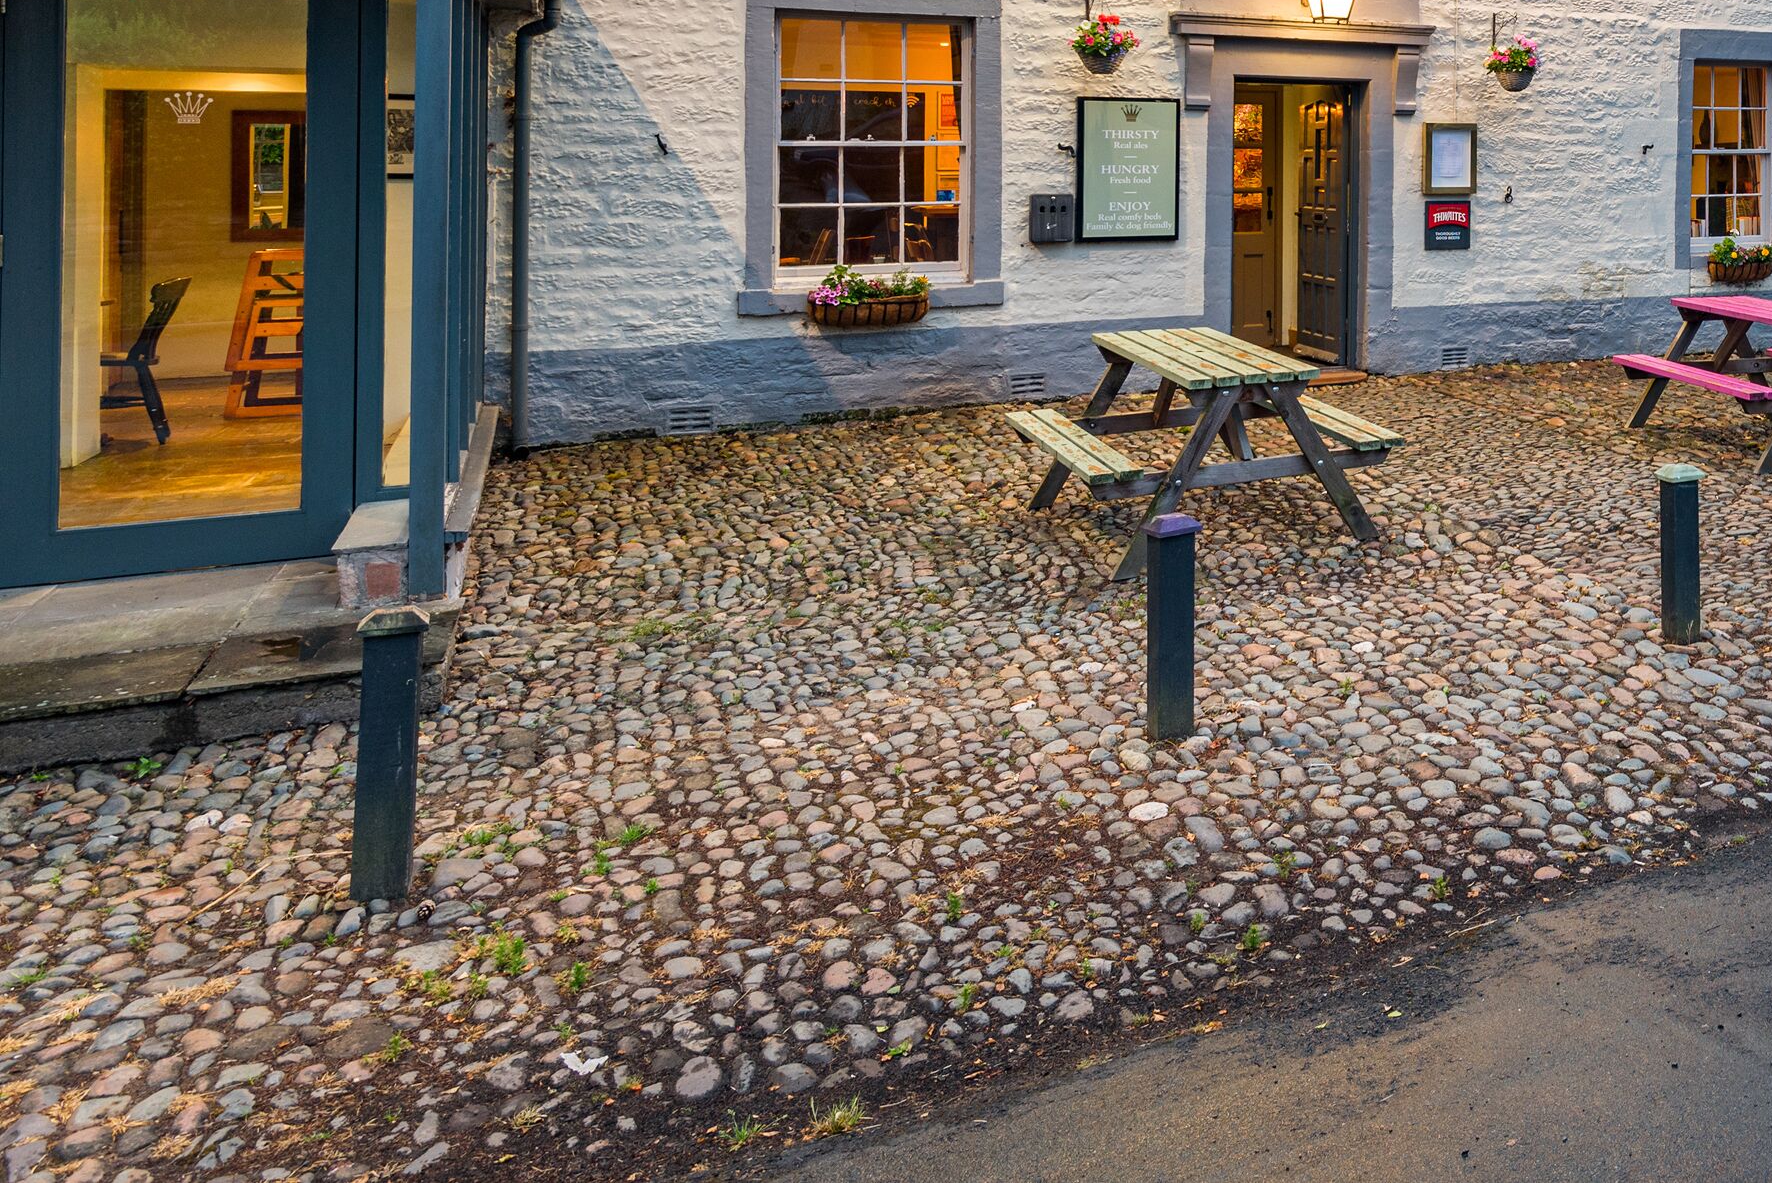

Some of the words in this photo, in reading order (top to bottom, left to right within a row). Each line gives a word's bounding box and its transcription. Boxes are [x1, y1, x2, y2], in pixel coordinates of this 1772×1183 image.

[1102, 130, 1159, 139] THIRSTY
[1101, 164, 1160, 174] HUNGRY
[1109, 176, 1131, 184] Fresh
[1133, 176, 1152, 184] food
[1110, 202, 1151, 212] ENJOY
[1098, 213, 1116, 221] Real
[1118, 213, 1142, 222] comfy
[1433, 211, 1466, 223] THWAITES
[1086, 222, 1113, 232] Family
[1126, 221, 1142, 231] dog
[1143, 220, 1173, 230] friendly
